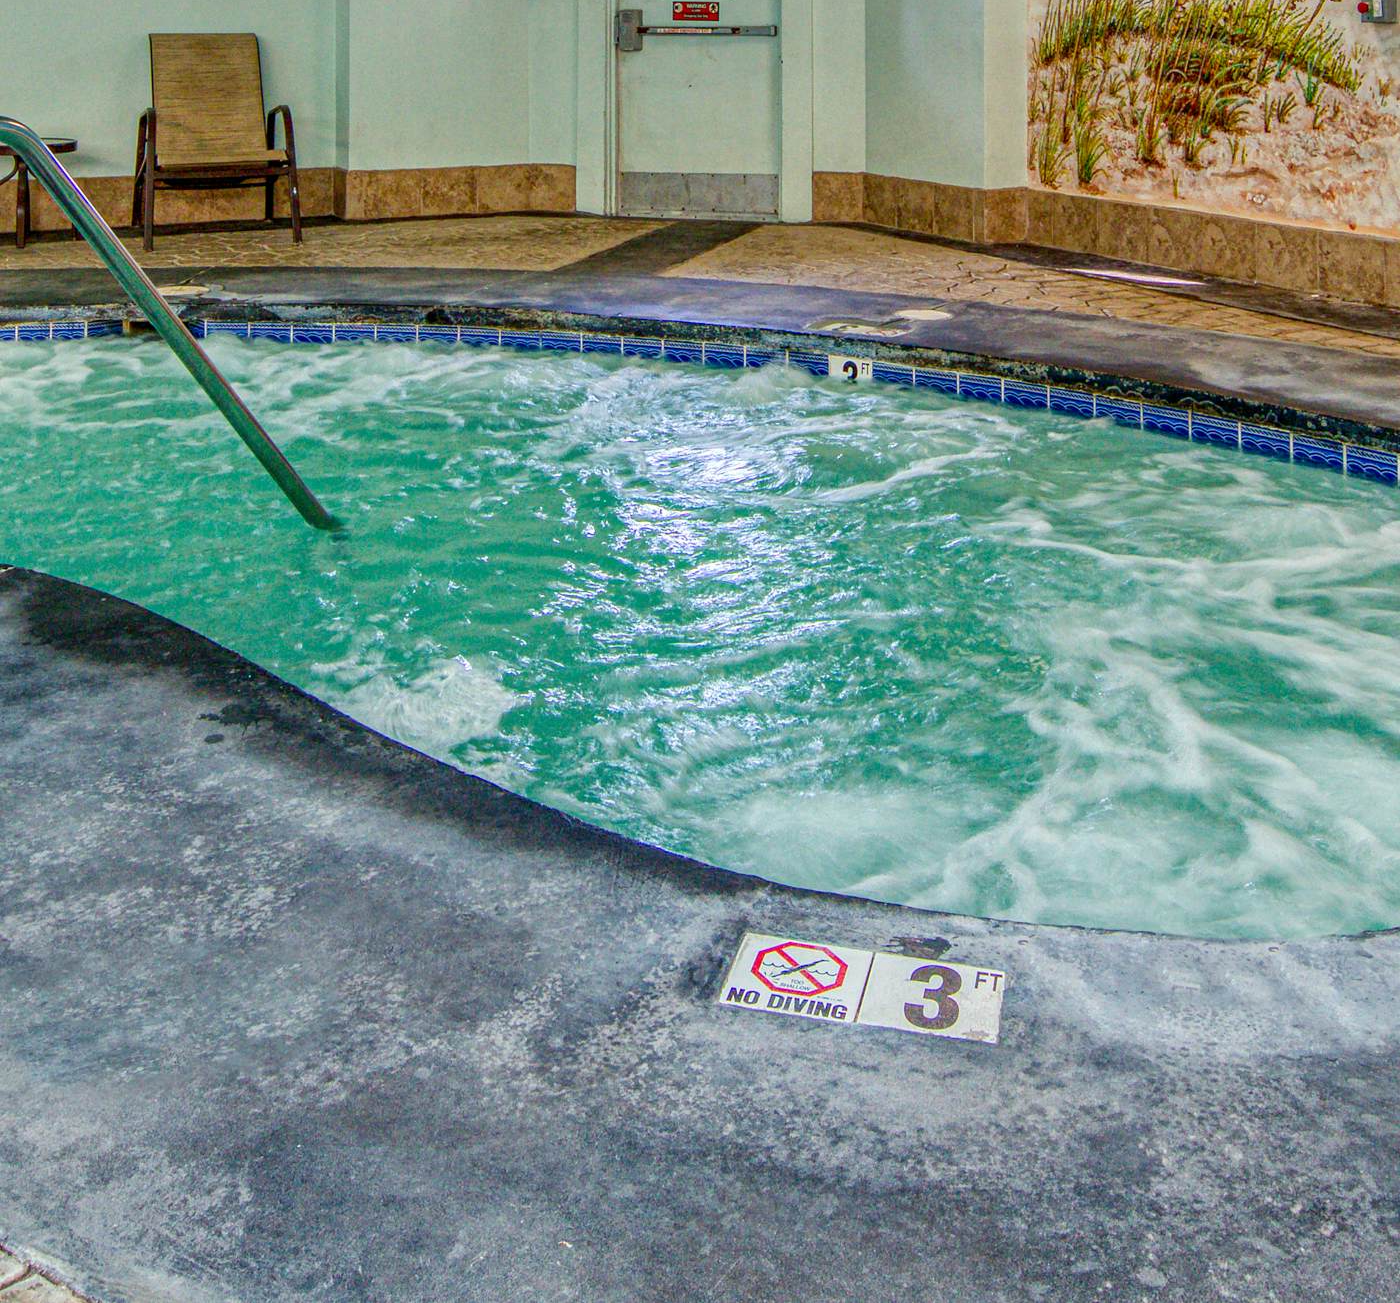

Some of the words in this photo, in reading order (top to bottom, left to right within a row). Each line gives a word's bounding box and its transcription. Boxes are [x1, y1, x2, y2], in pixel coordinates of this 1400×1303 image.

[861, 362, 870, 375] FT
[780, 982, 811, 992] SHALLOW
[791, 978, 804, 986] TOO
[726, 986, 760, 1004] NO
[766, 993, 848, 1020] DIVING
[903, 964, 963, 1031] 3
[974, 971, 1004, 992] FT
